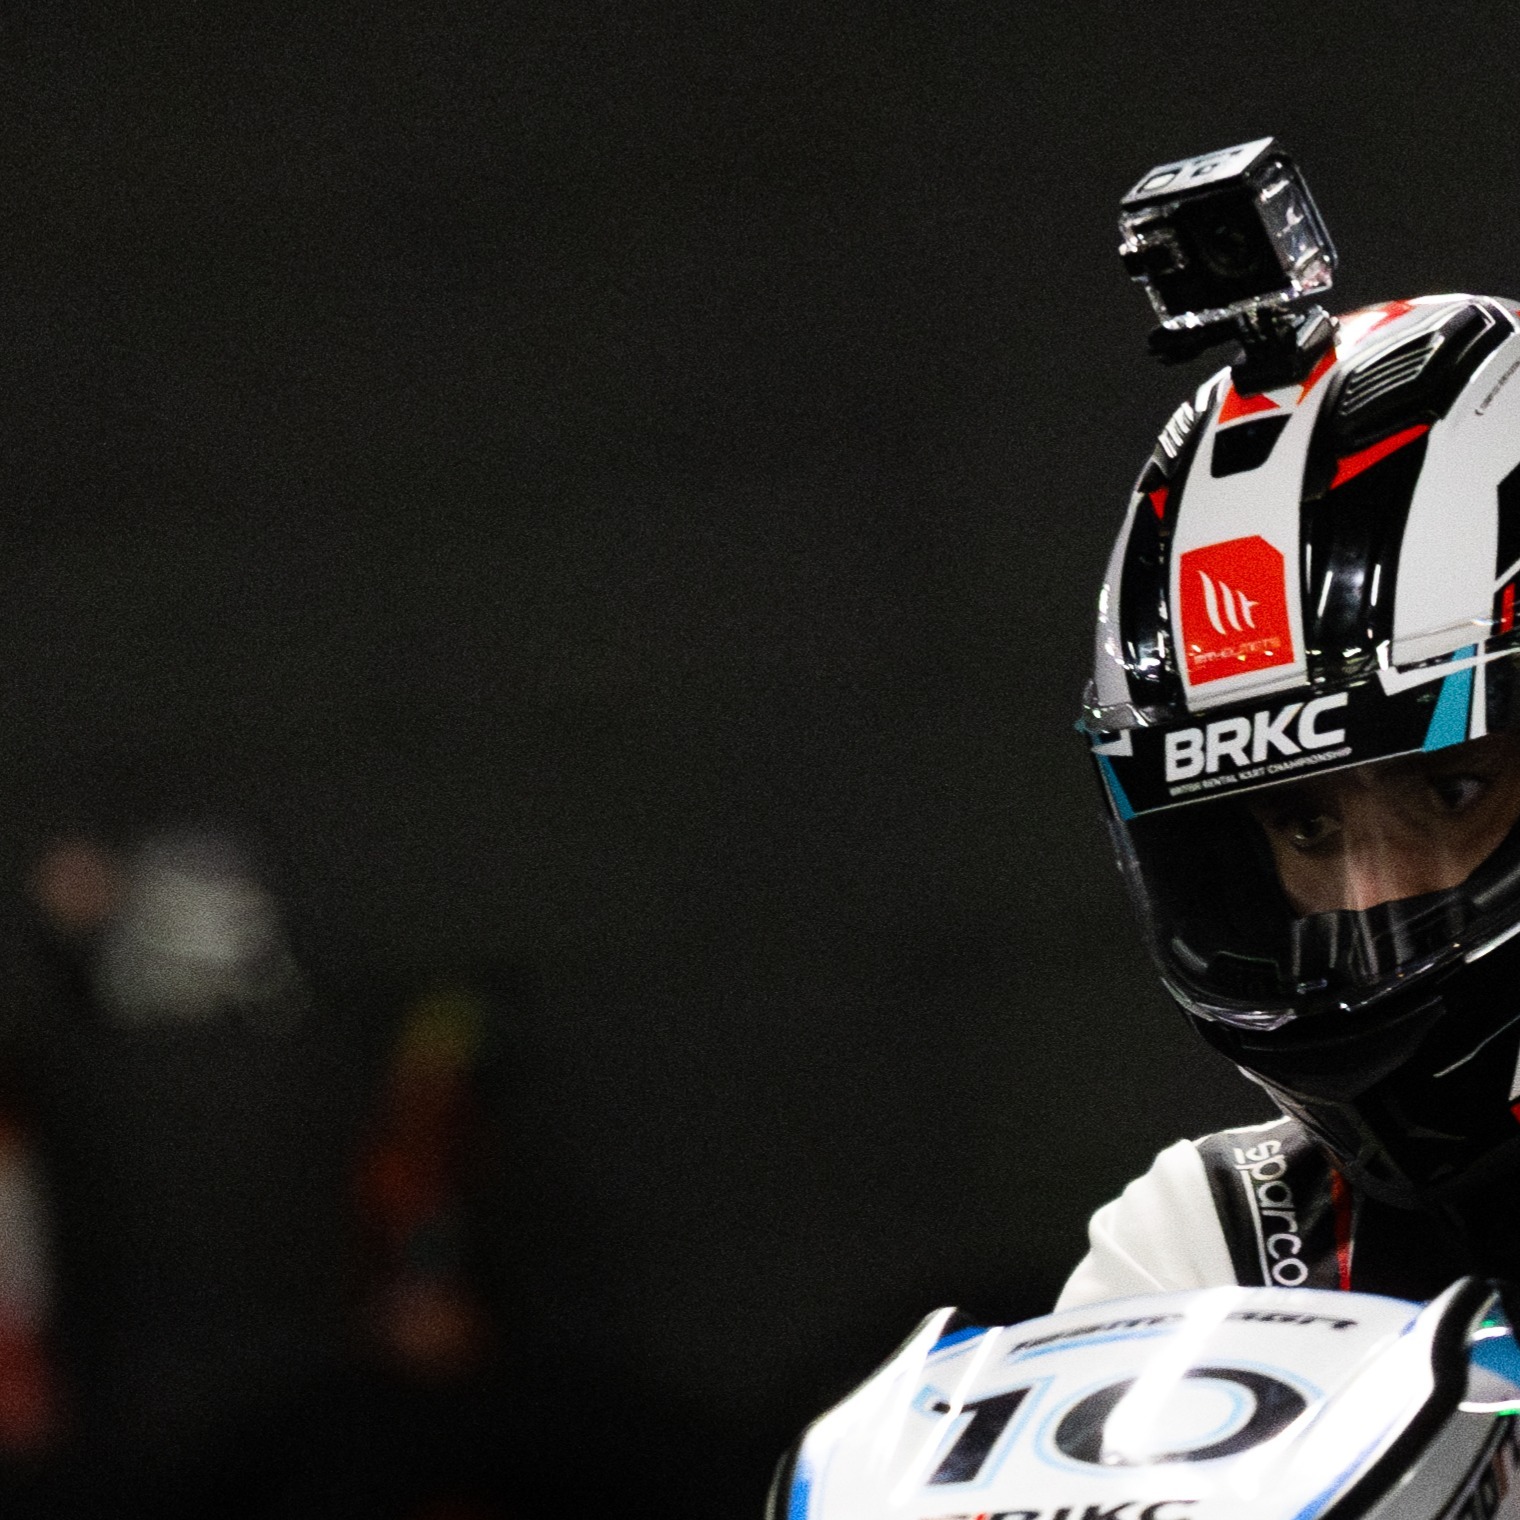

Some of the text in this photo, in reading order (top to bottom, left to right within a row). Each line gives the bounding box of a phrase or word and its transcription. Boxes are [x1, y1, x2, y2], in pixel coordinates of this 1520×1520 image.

[1165, 691, 1349, 783] BRKC
[1234, 1140, 1309, 1288] sparco
[927, 1366, 1308, 1487] 10
